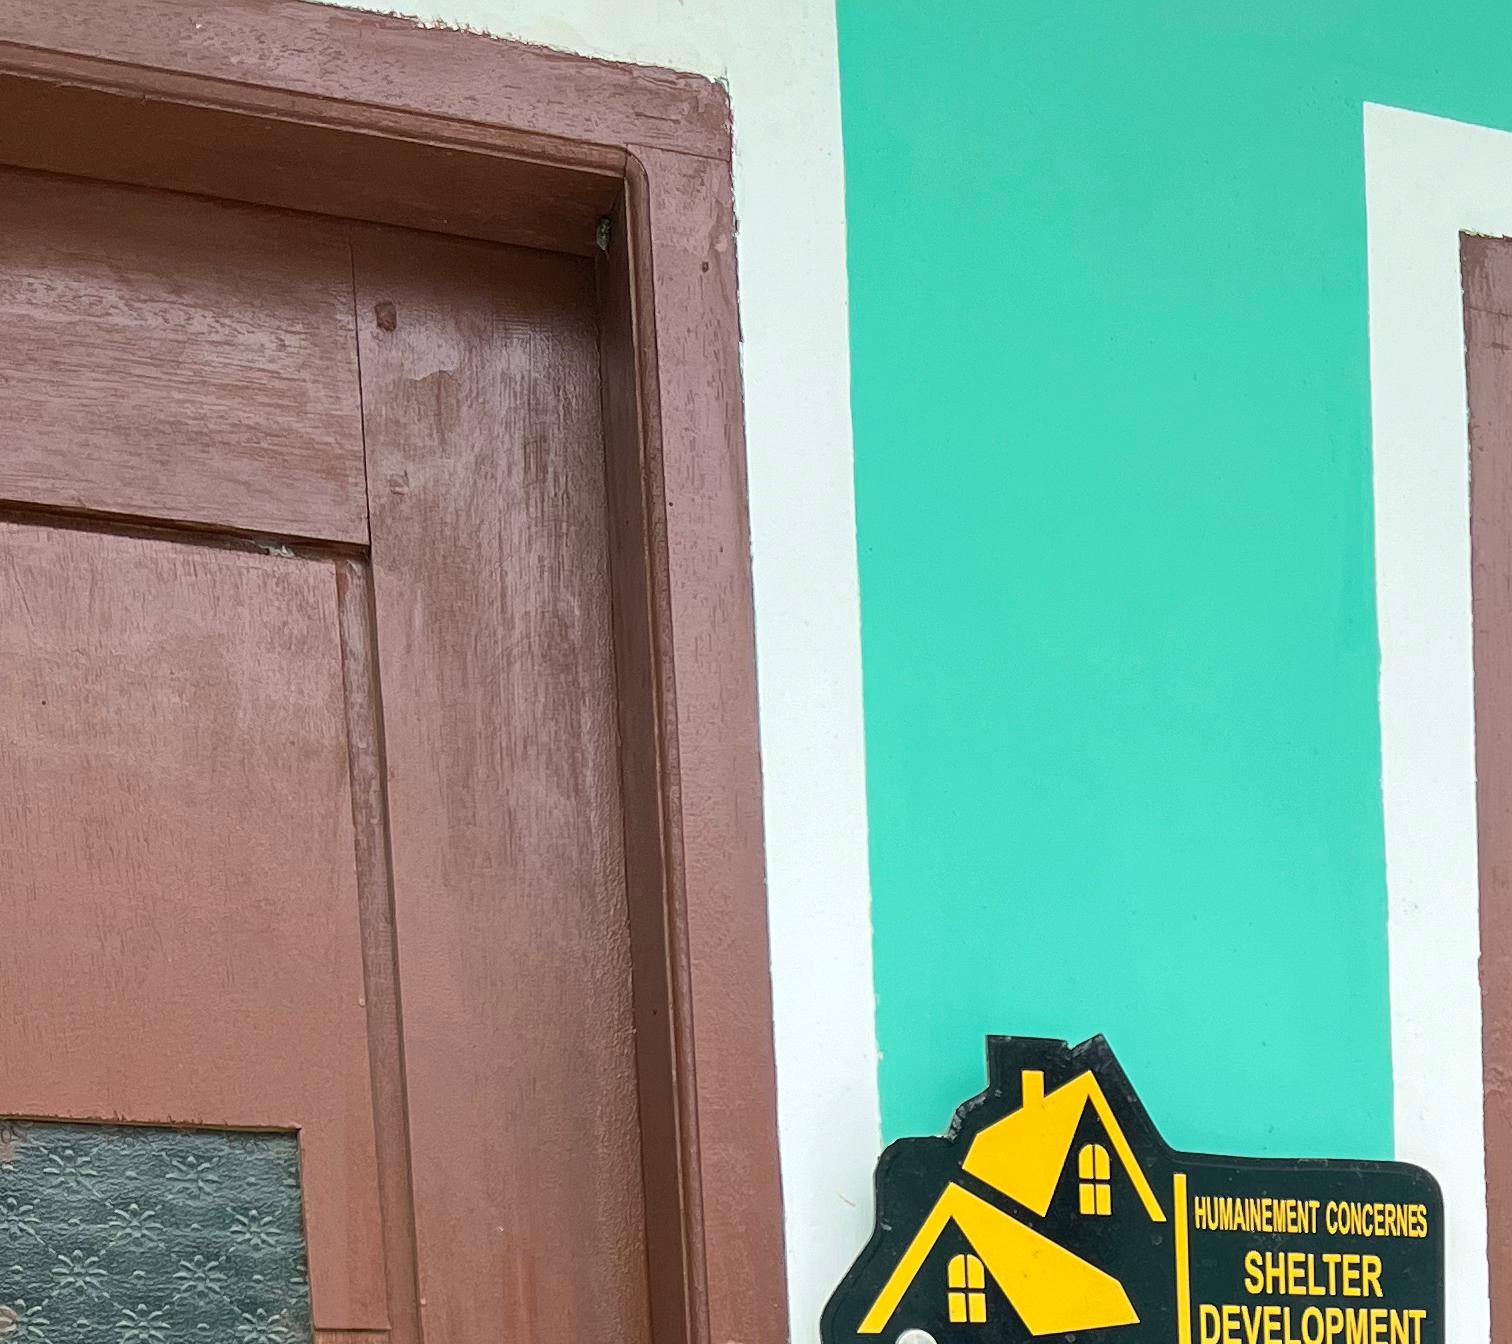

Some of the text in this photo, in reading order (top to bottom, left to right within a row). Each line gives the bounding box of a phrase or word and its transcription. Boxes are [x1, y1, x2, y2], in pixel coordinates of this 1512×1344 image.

[1194, 1196, 1428, 1239] HUMAINEMENT CONCERNES
[1244, 1250, 1383, 1297] SHELTER
